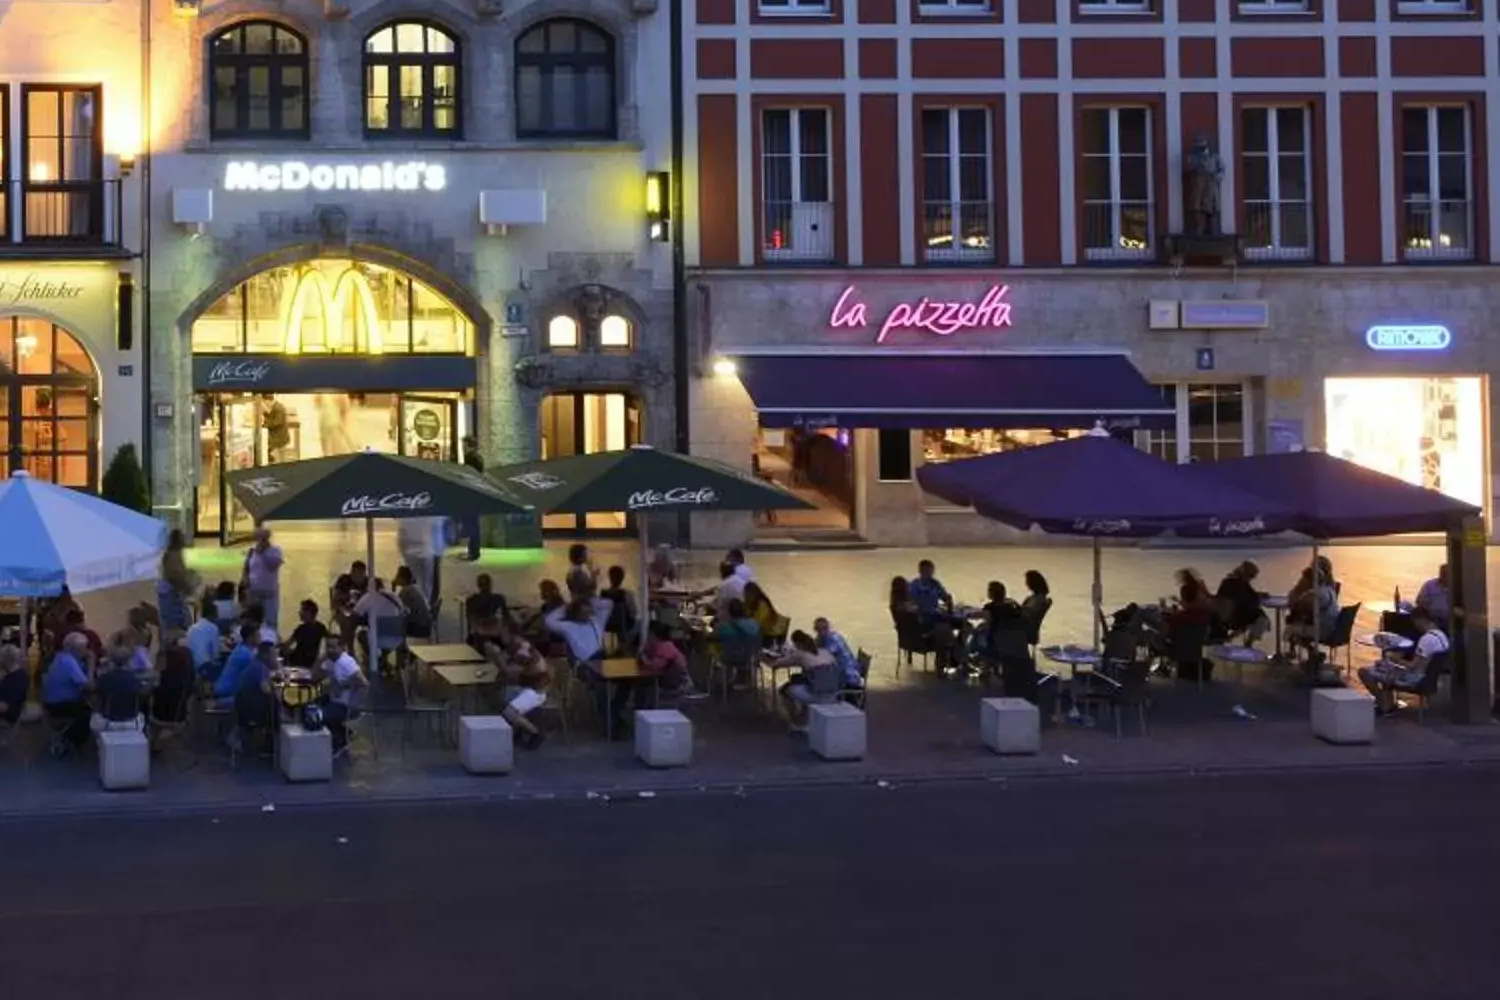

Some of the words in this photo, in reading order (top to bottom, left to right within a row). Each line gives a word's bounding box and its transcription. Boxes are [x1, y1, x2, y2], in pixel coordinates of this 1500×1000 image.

[224, 160, 447, 191] McDonald's
[6, 272, 84, 304] Schlicker
[876, 284, 1012, 343] pizzetta
